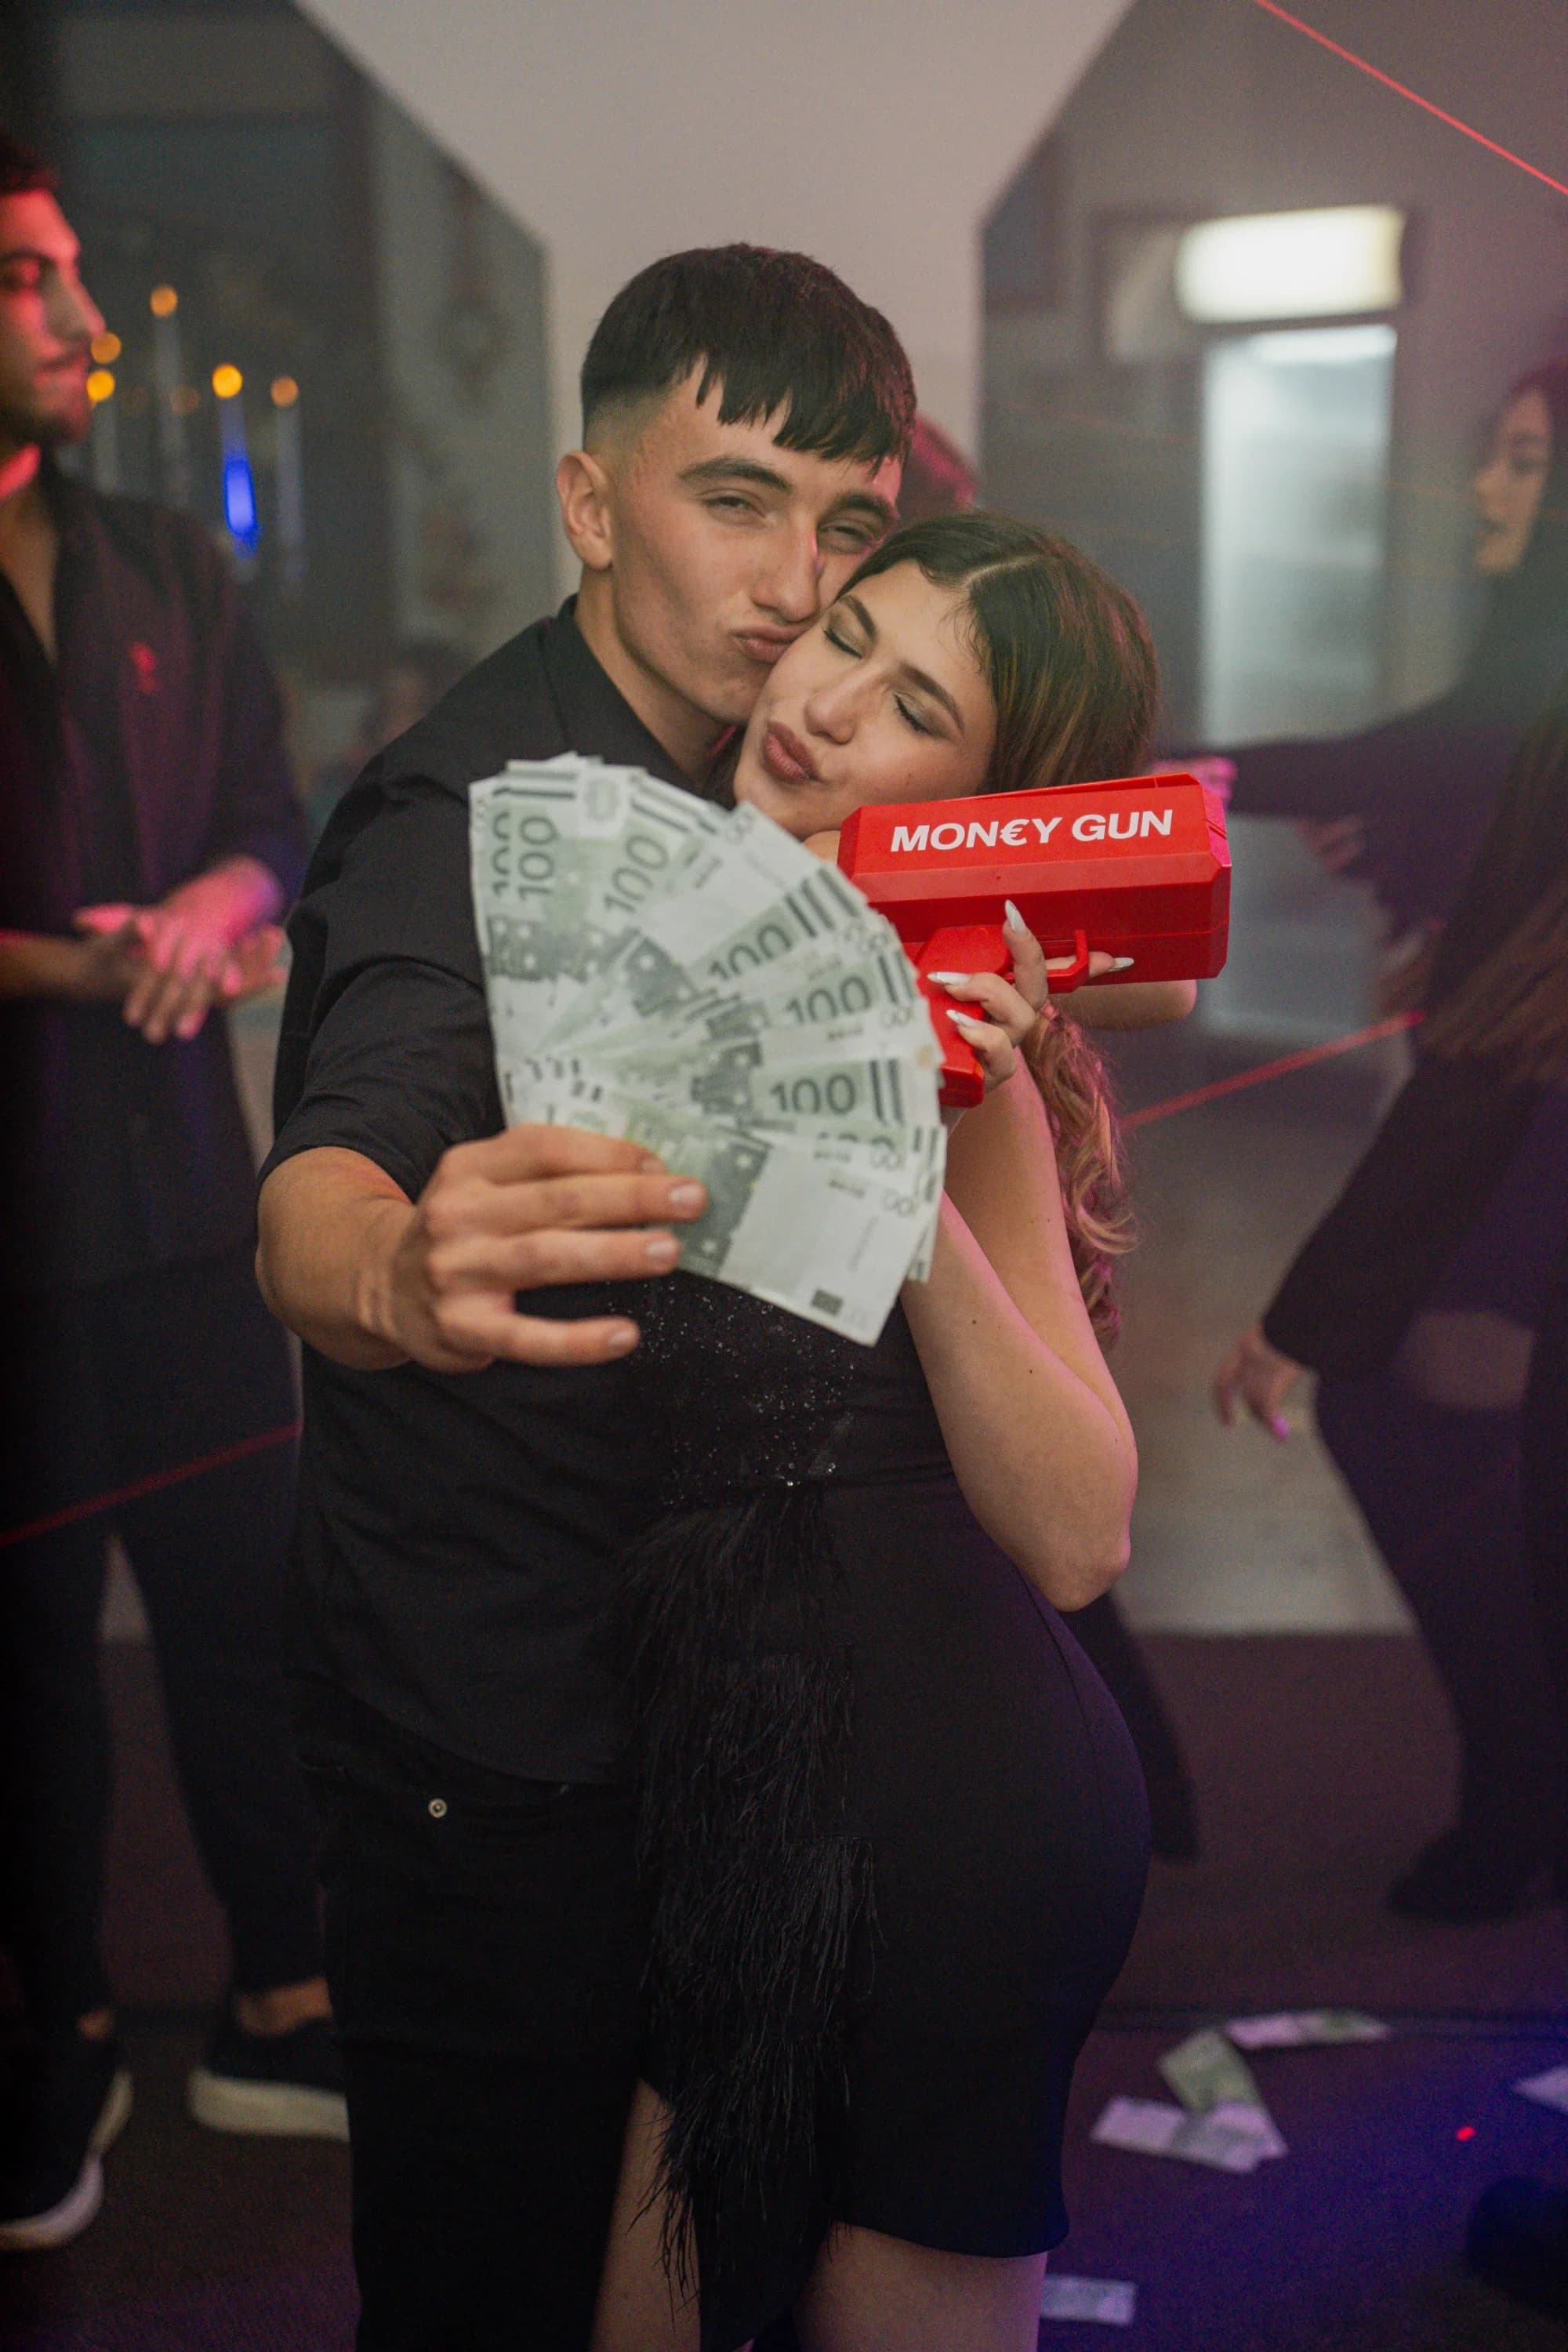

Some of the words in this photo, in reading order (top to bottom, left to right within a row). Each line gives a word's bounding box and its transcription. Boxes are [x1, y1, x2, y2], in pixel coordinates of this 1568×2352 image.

[1072, 809, 1174, 841] GUN
[517, 815, 559, 902] 100
[603, 835, 670, 916] 100
[708, 924, 794, 982] 100
[785, 975, 873, 1023] 100
[769, 1072, 857, 1116] 100
